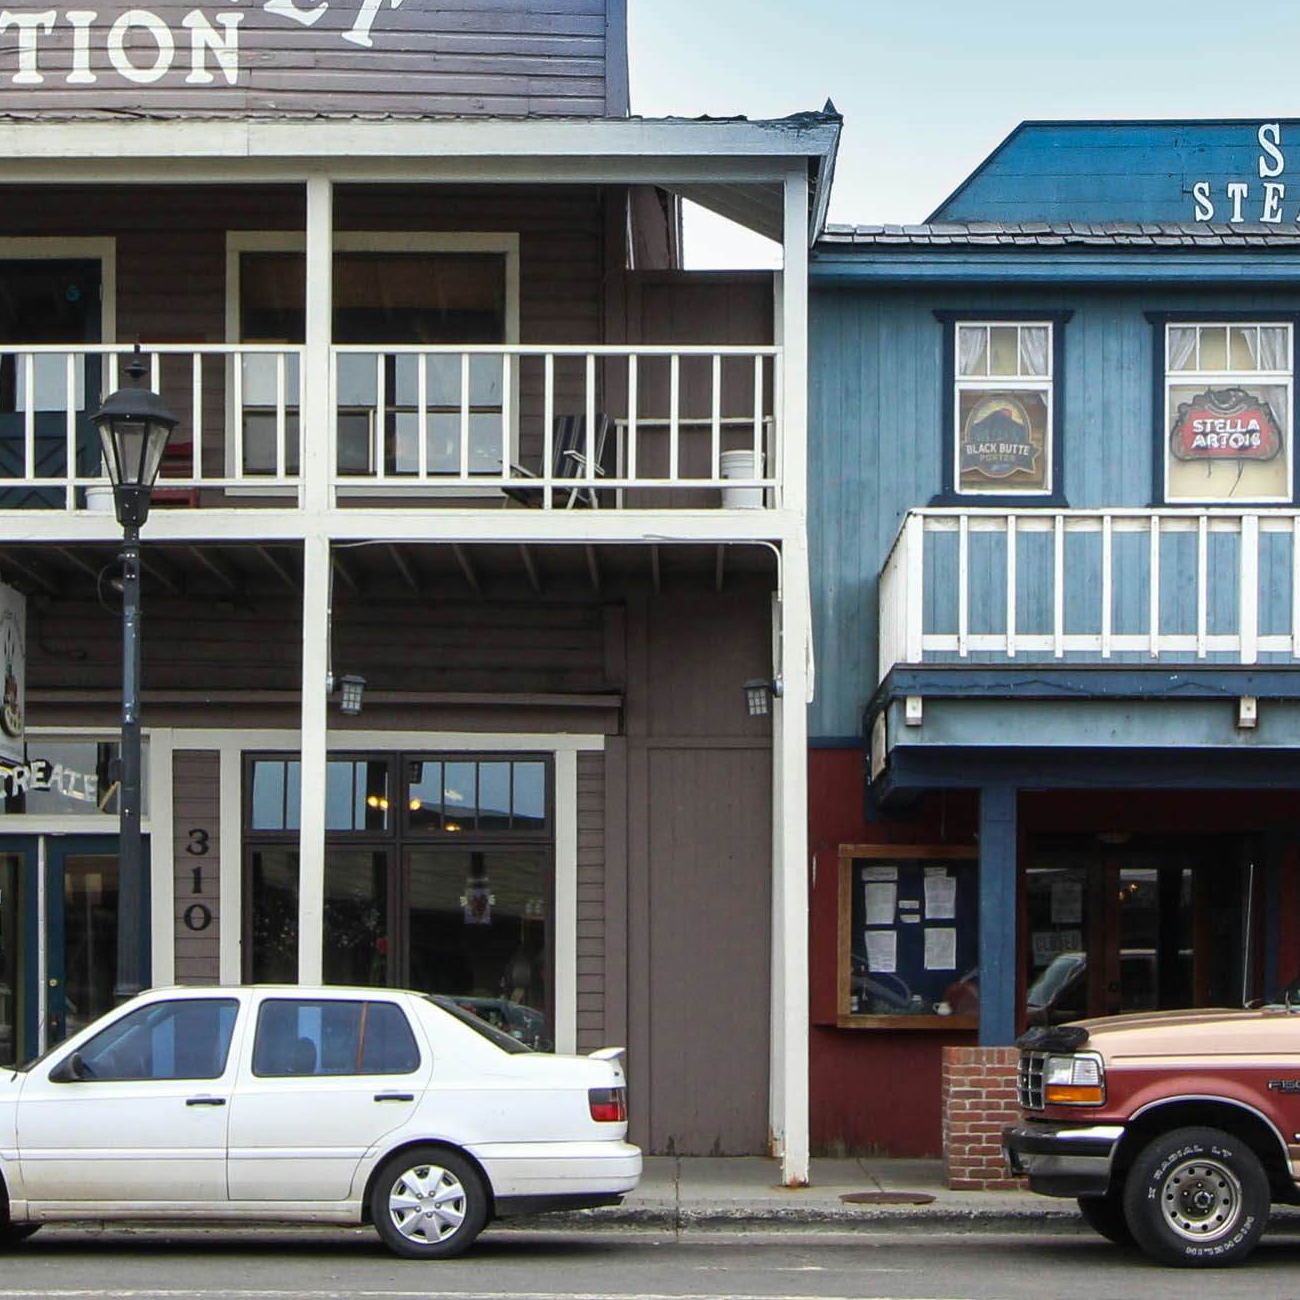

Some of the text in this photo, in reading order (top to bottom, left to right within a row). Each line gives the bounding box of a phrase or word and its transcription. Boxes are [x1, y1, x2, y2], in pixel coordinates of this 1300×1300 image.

[1192, 419, 1260, 432] STELLA
[966, 443, 1031, 456] BLACK BUTTE
[184, 828, 212, 931] 310
[1153, 1145, 1204, 1180] RADIAL
[1211, 1145, 1232, 1158] LT
